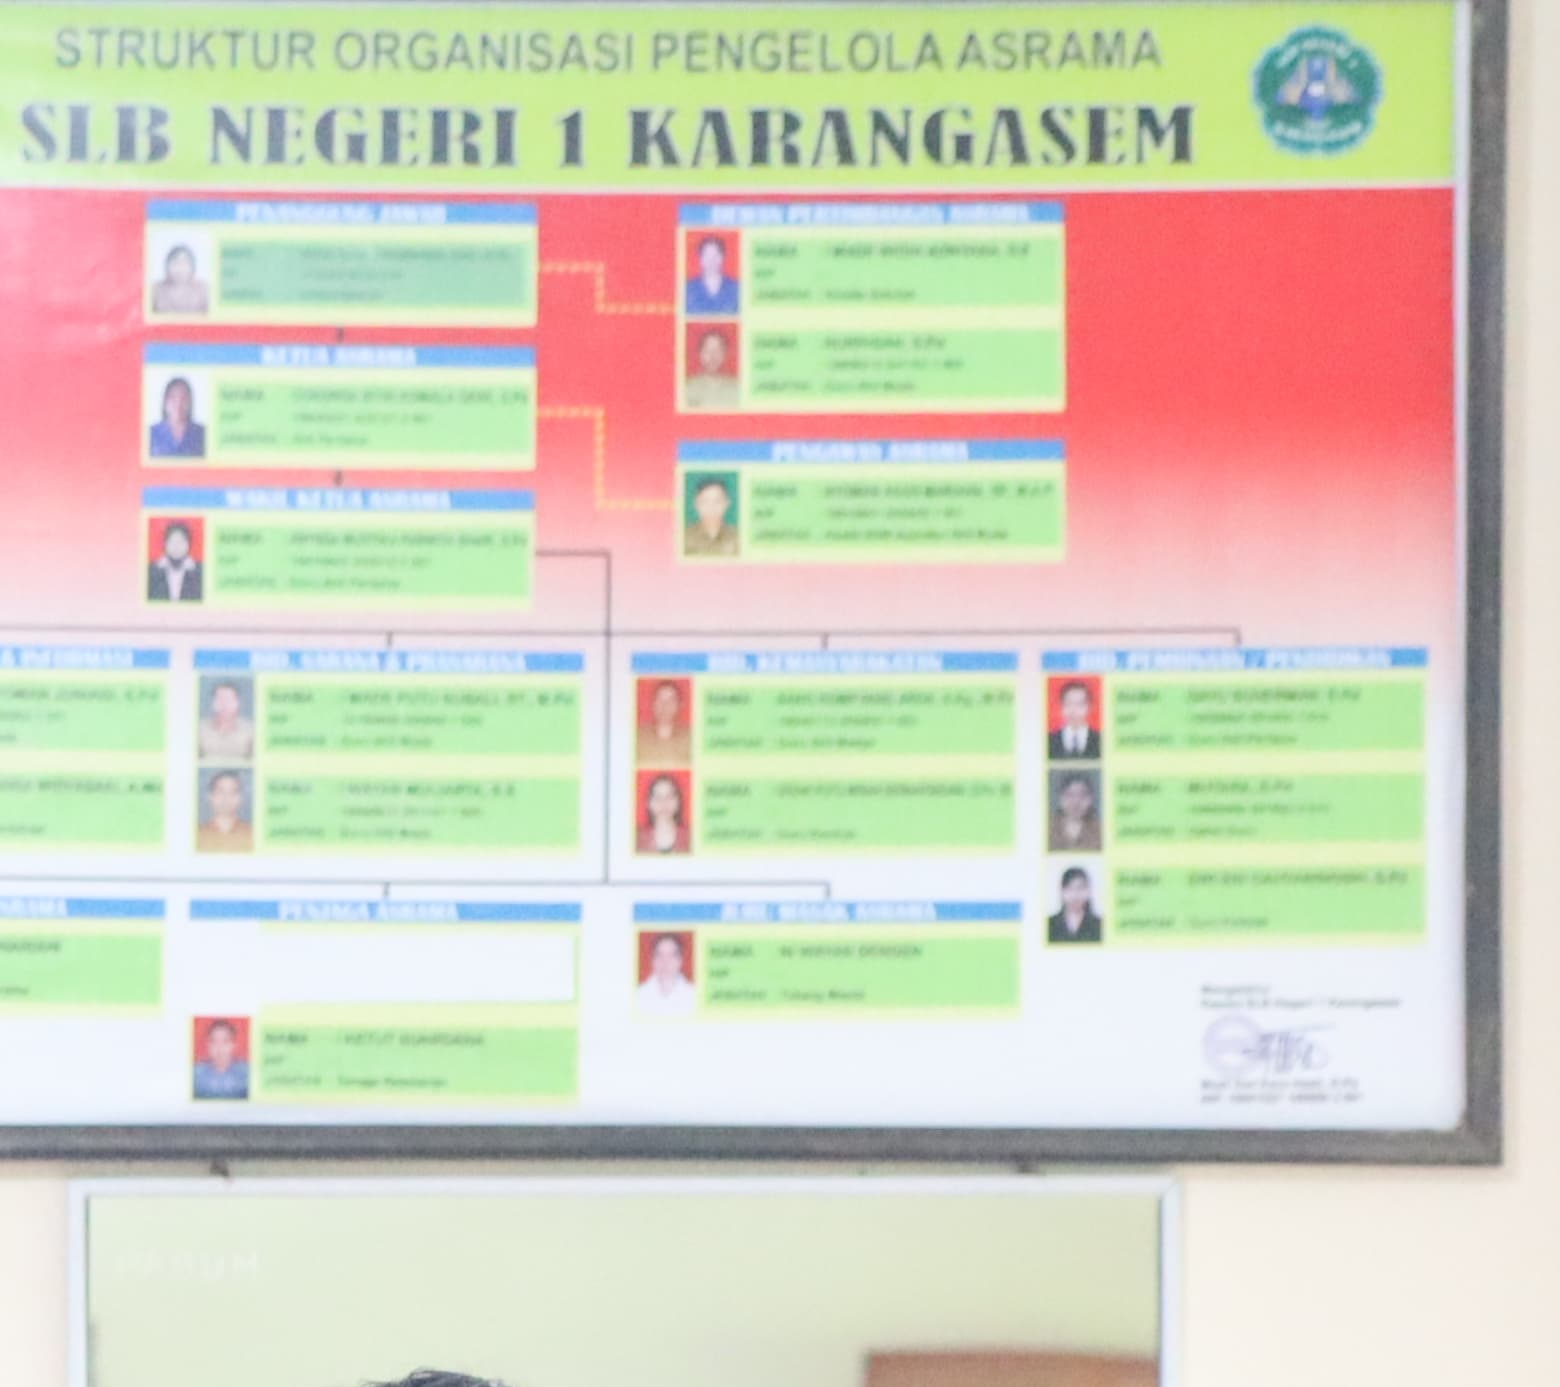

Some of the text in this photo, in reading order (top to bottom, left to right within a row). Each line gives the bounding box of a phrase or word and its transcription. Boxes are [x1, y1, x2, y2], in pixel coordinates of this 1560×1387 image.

[54, 28, 1163, 73] STRUKTUR ORGANISASI PENGELOLA ASRAMA
[19, 102, 1195, 169] SLB NEGERI 1 KARANGASEM
